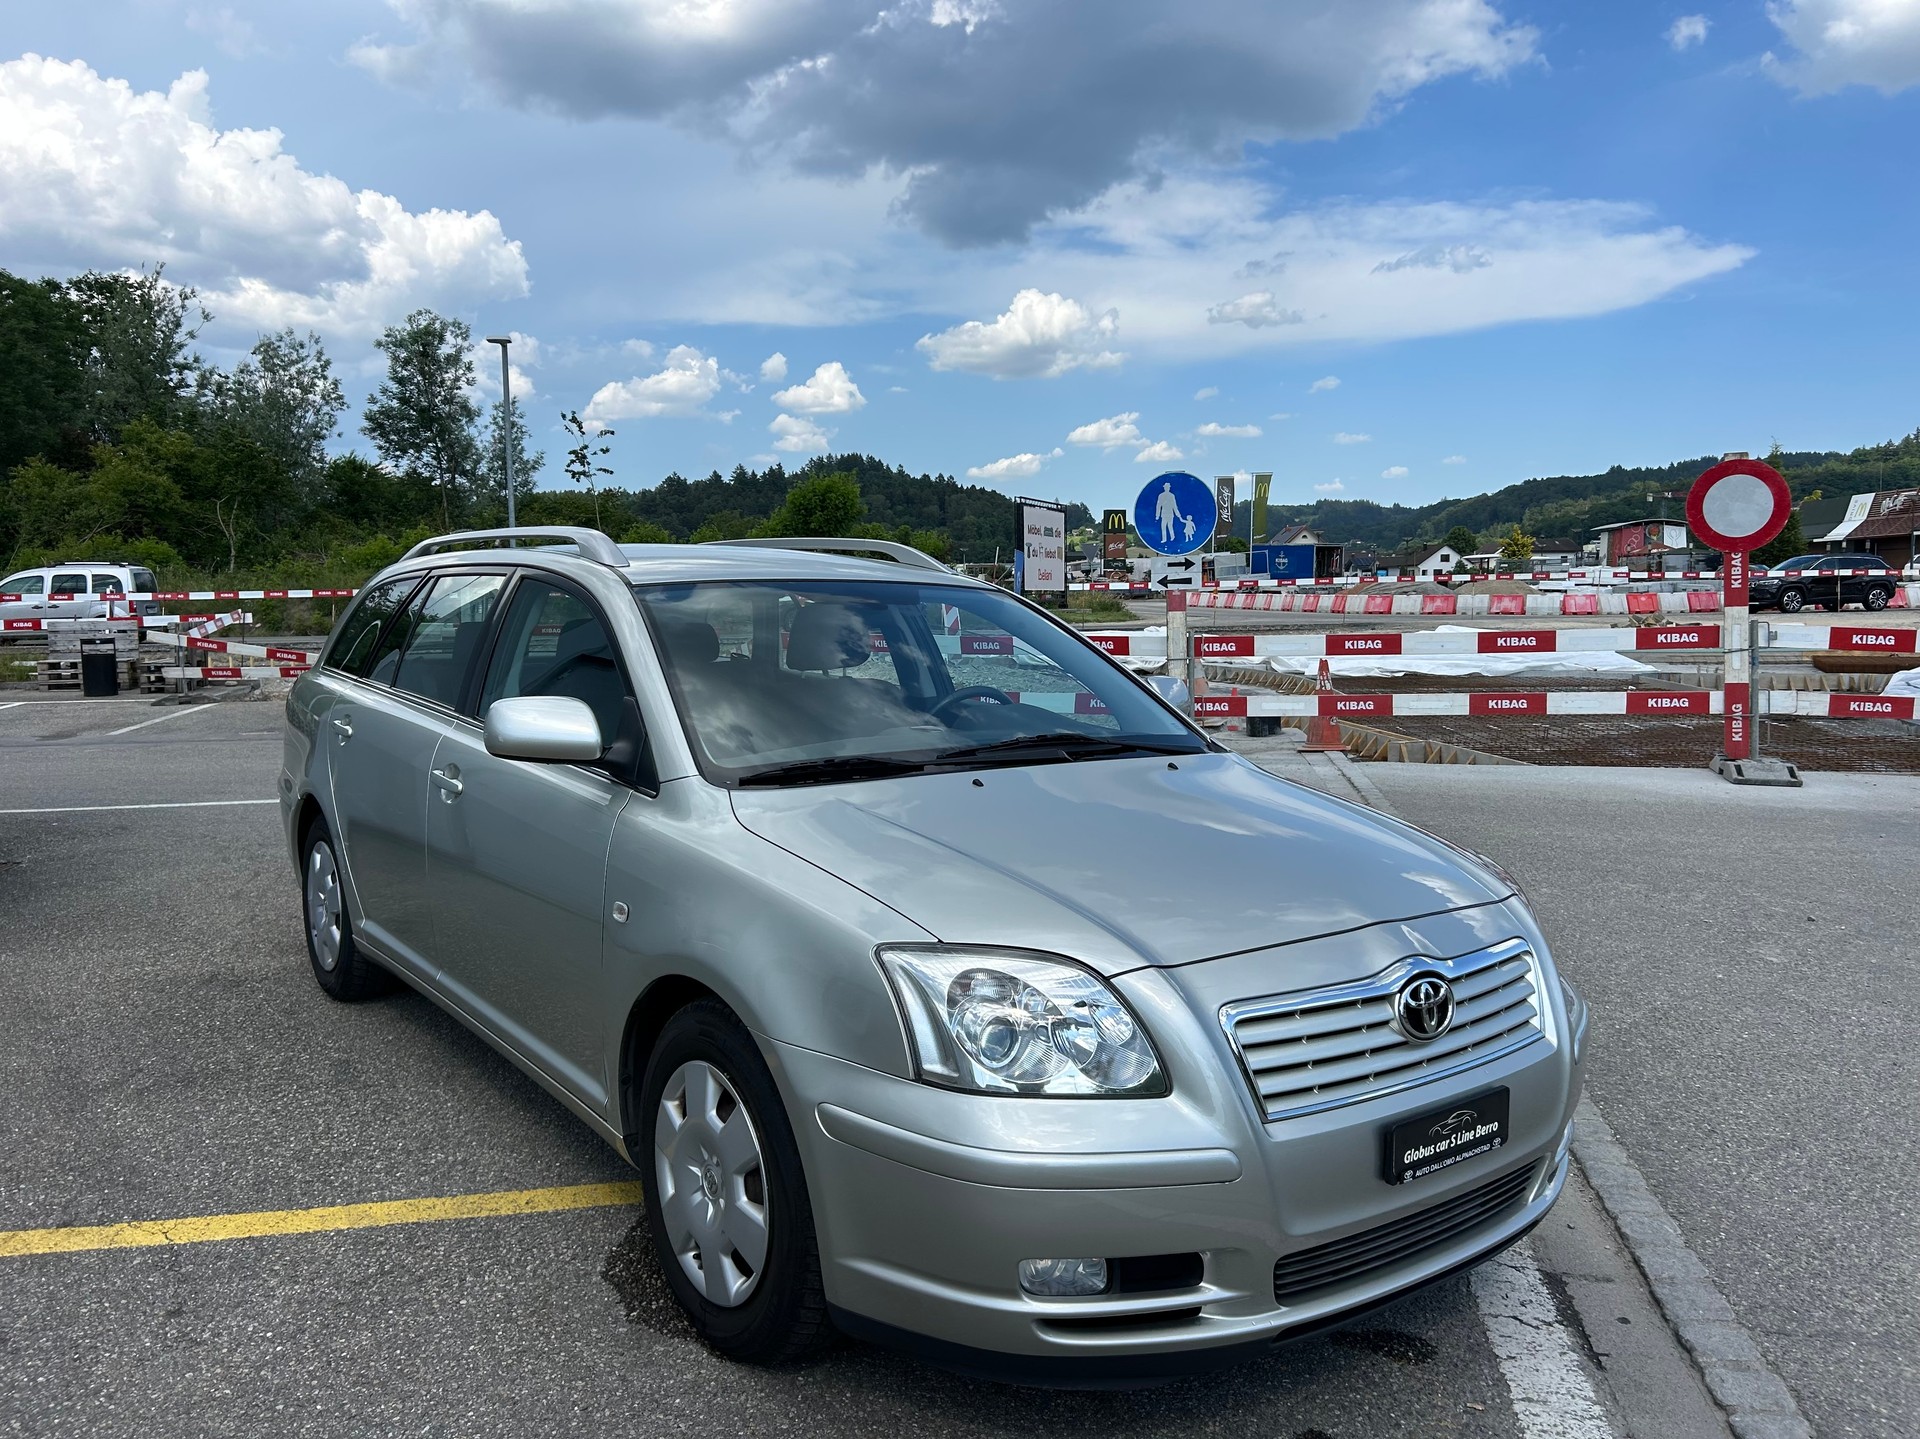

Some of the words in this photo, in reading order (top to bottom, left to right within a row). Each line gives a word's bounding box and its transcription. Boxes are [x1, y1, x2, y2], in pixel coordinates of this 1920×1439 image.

[1497, 637, 1537, 647] KIBAG
[1657, 633, 1699, 643] KIBAG
[1852, 634, 1895, 645] KIBAG
[196, 641, 218, 649] KIBAG
[973, 641, 1000, 650] KIBAG
[1201, 642, 1236, 652] KIBAG
[1344, 640, 1382, 650] KIBAG
[276, 652, 297, 660] KIBAG
[1194, 702, 1229, 711] KIBAG
[1337, 701, 1375, 710] KIBAG
[1488, 699, 1528, 709] KIBAG
[1647, 698, 1689, 708] KIBAG
[1849, 701, 1893, 713] KIBAG
[1732, 703, 1743, 741] KIBAG
[1404, 1147, 1435, 1164] Globus
[1435, 1141, 1450, 1153] car
[1450, 1135, 1456, 1147] S
[1457, 1130, 1475, 1144] Line
[1475, 1121, 1499, 1138] Berro
[1415, 1166, 1430, 1177] AUTO
